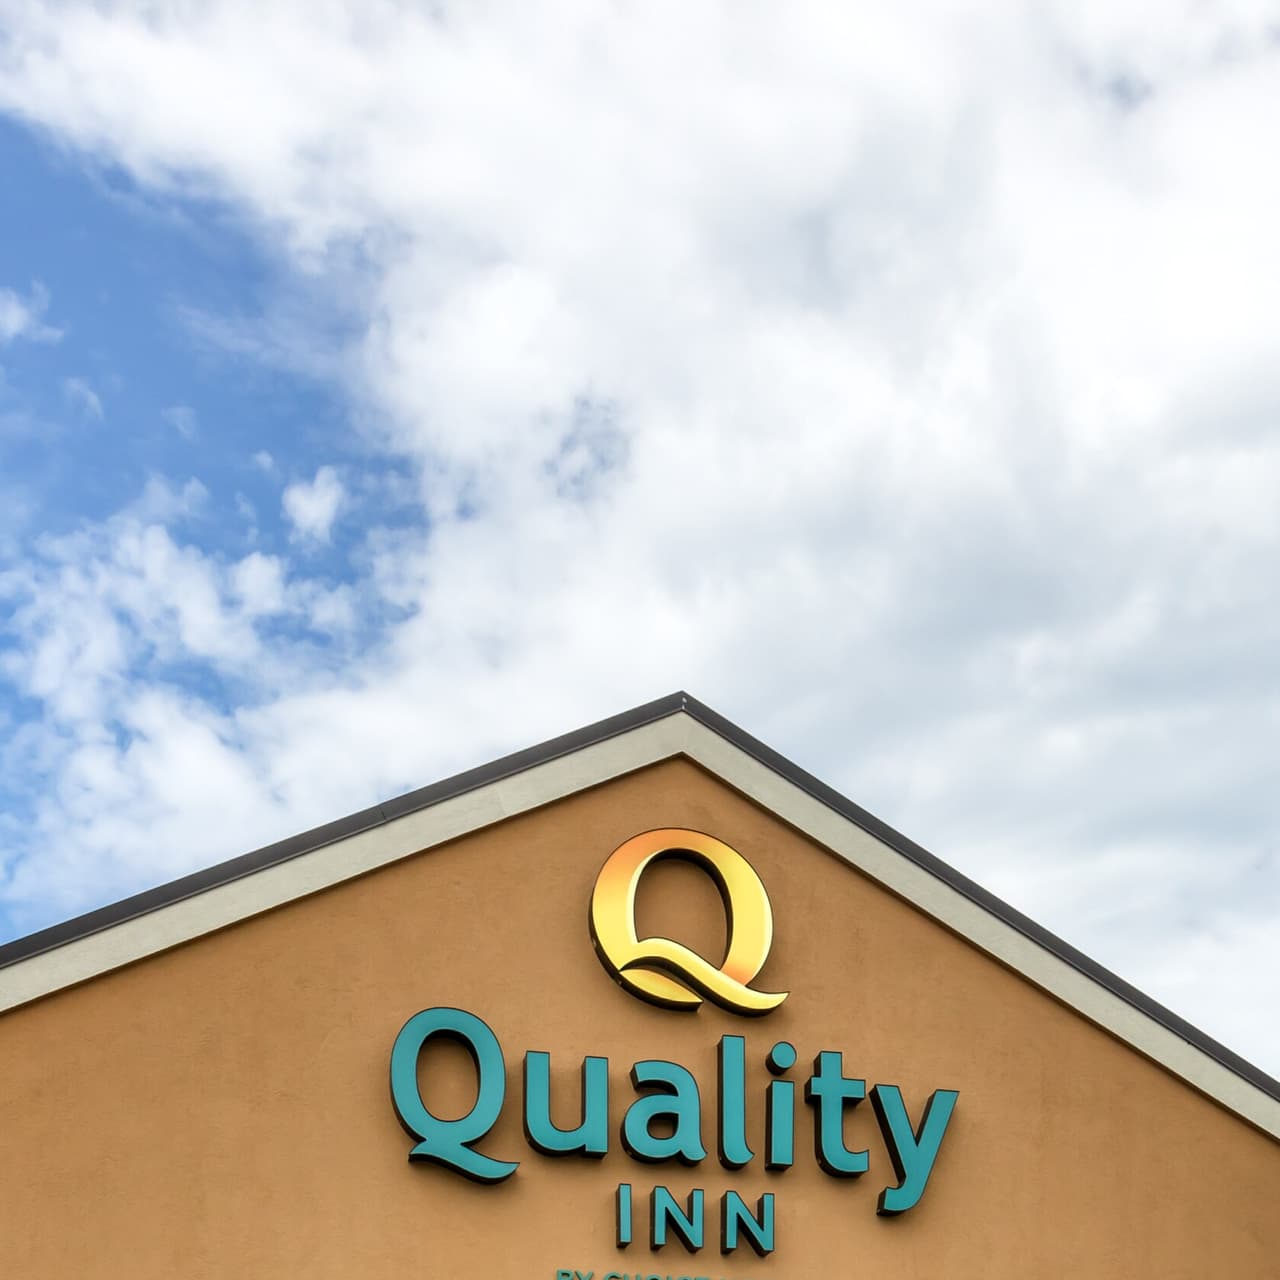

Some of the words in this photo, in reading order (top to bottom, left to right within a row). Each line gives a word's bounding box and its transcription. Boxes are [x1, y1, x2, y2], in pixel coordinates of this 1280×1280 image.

[589, 827, 789, 1017] Q
[389, 1007, 960, 1216] Quality
[616, 1183, 775, 1257] INN
